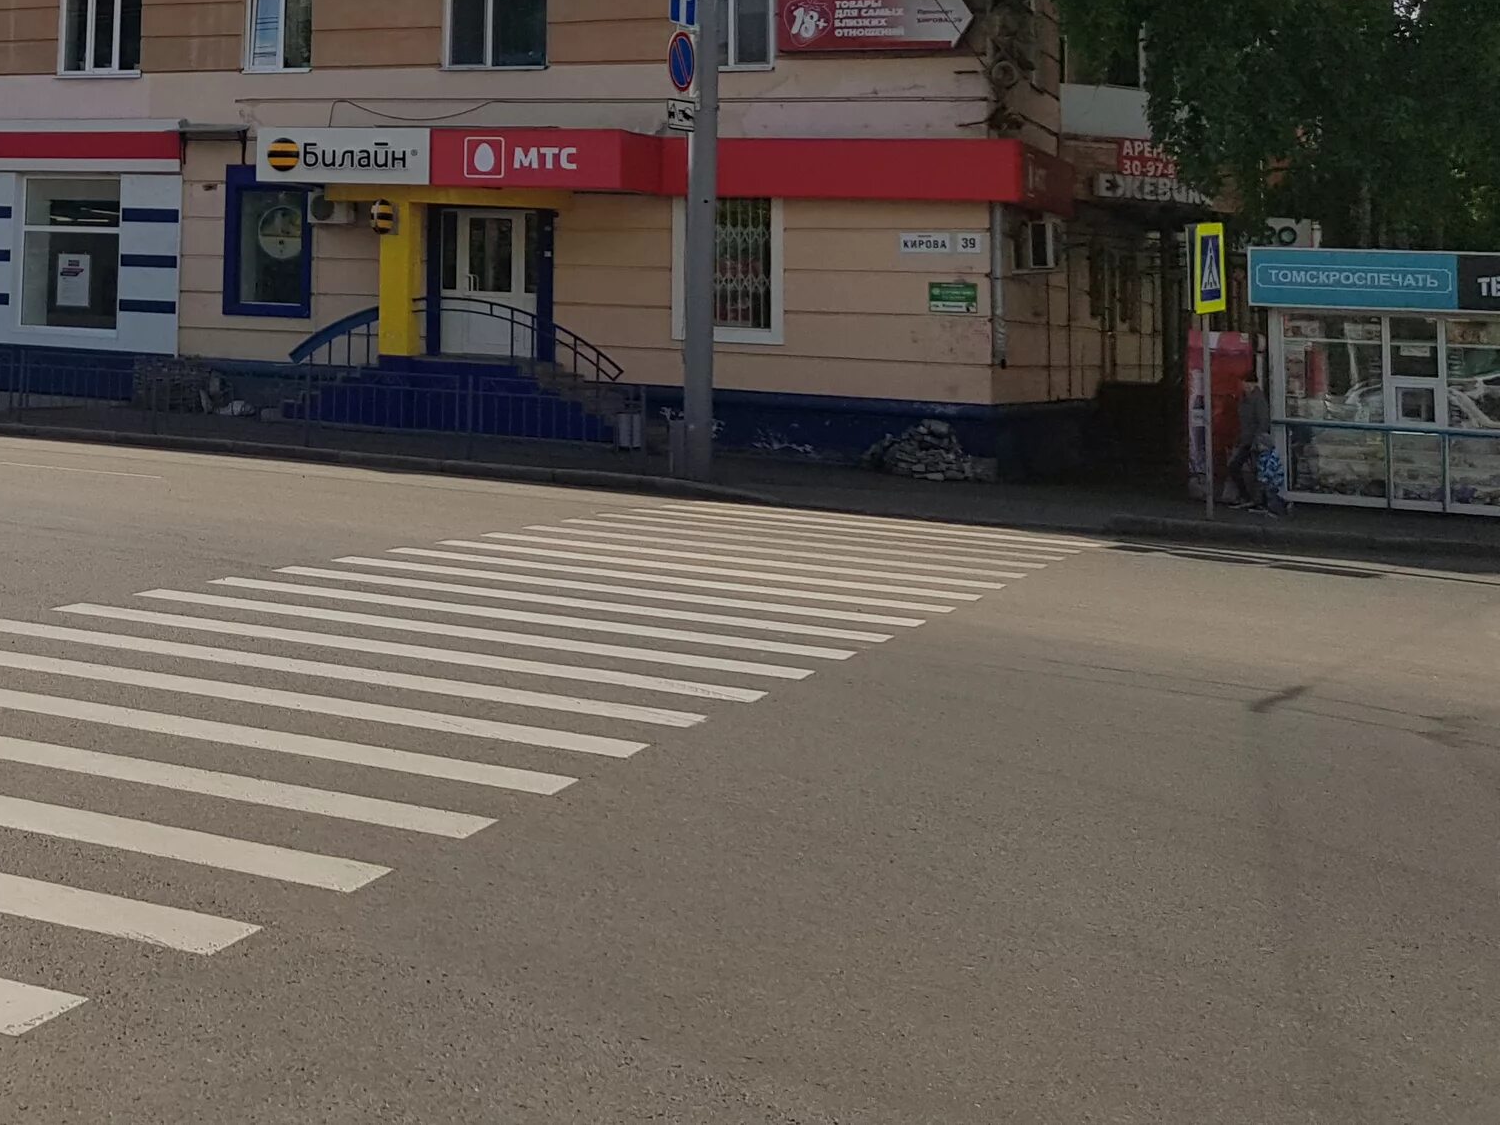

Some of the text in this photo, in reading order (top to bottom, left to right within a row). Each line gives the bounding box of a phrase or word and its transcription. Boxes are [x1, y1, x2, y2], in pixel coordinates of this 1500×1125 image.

[835, 0, 882, 9] ТОВАРЫ
[835, 9, 858, 18] ДЛЯ
[792, 8, 827, 37] 18+
[835, 19, 887, 27] БЛИЗКИХ
[513, 147, 577, 169] МТС
[903, 239, 947, 249] КИРОВА
[961, 237, 976, 249] 39
[1267, 268, 1439, 288] ТОМСКРОСПЕЧАТЬ
